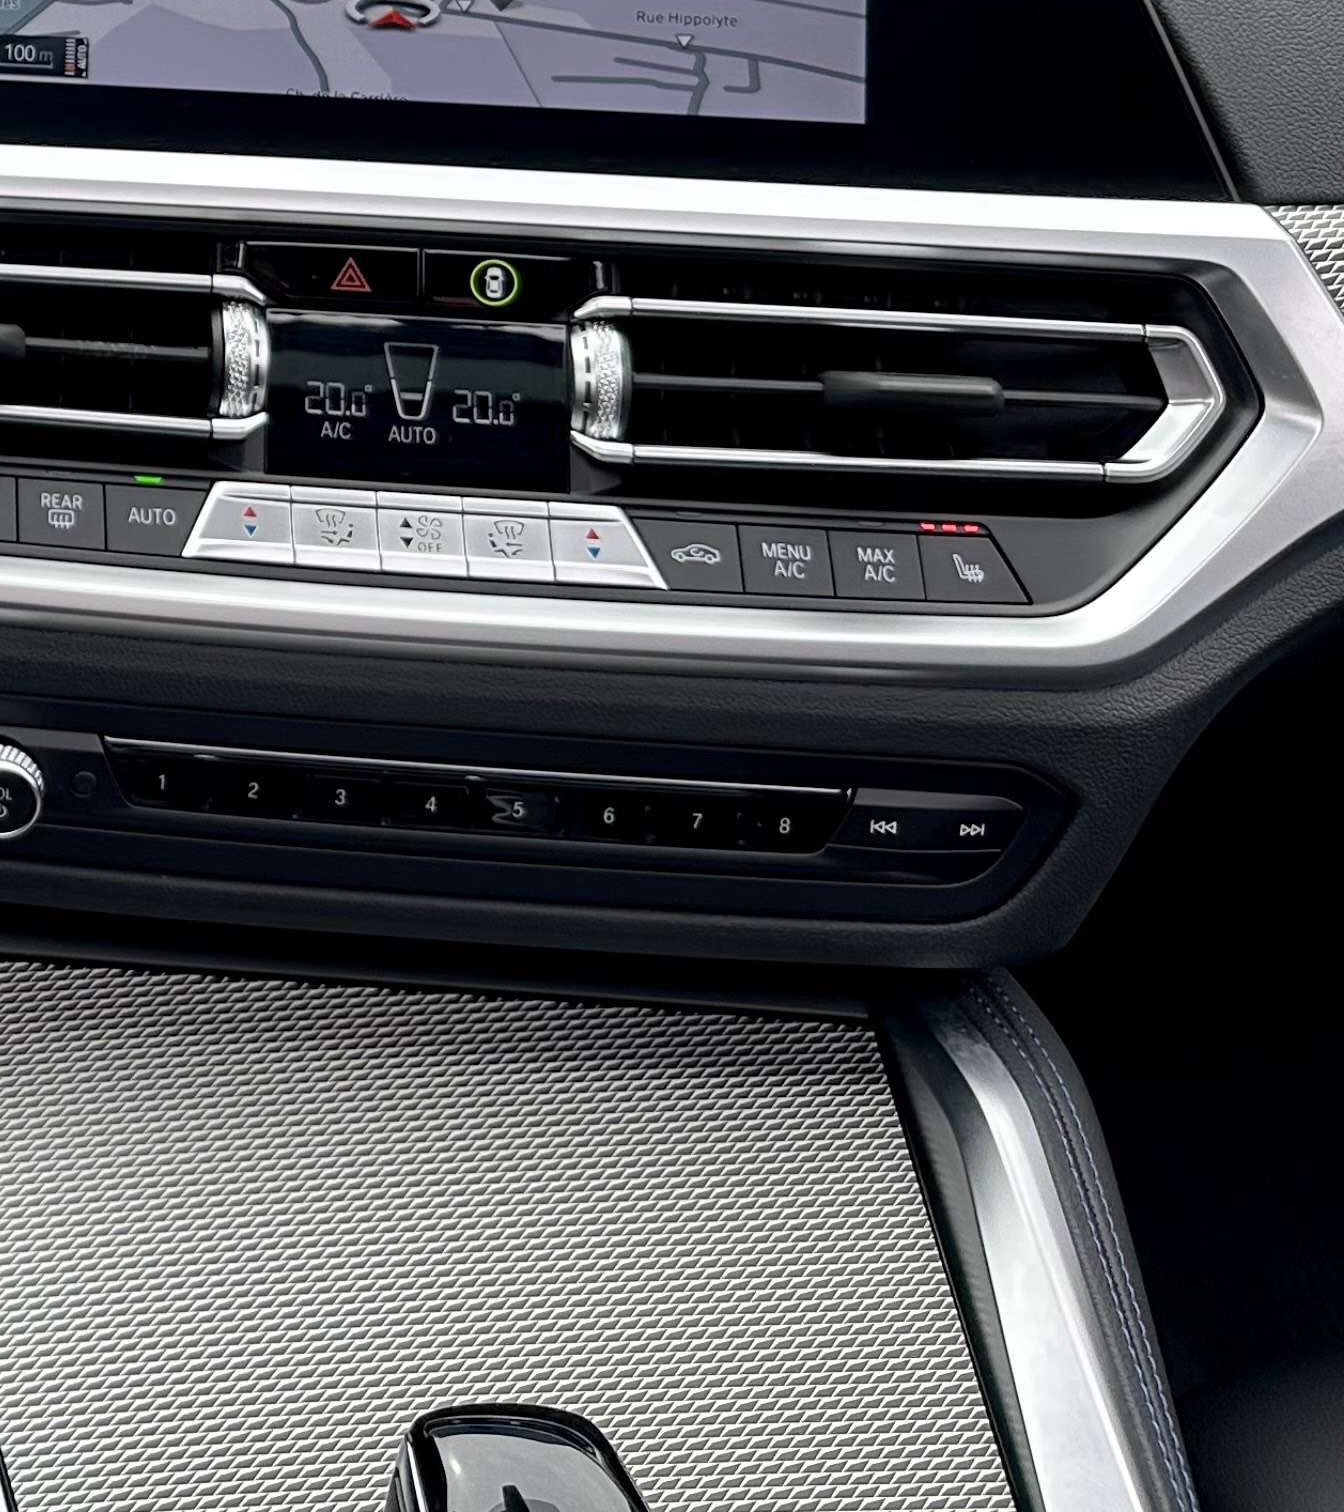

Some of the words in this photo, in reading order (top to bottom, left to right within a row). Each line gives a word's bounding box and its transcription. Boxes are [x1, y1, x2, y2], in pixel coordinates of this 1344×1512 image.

[636, 10, 664, 23] Rue
[668, 13, 738, 28] Hippolyte
[5, 44, 35, 62] 100
[39, 51, 53, 61] m
[321, 422, 352, 439] A/C
[389, 426, 436, 444] AUTO
[40, 492, 83, 511] REAR
[128, 506, 177, 527] AUTO
[418, 541, 443, 554] OFF
[762, 541, 812, 562] MENU
[857, 545, 895, 565] MAX
[774, 560, 806, 580] A/C
[864, 563, 896, 583] A/C
[158, 774, 167, 791] 1
[247, 782, 259, 799] 2
[334, 788, 346, 806] 3
[424, 796, 438, 814] 4
[513, 801, 524, 819] 5
[603, 806, 615, 824] 6
[691, 812, 703, 830] 7
[778, 817, 791, 835] 8
